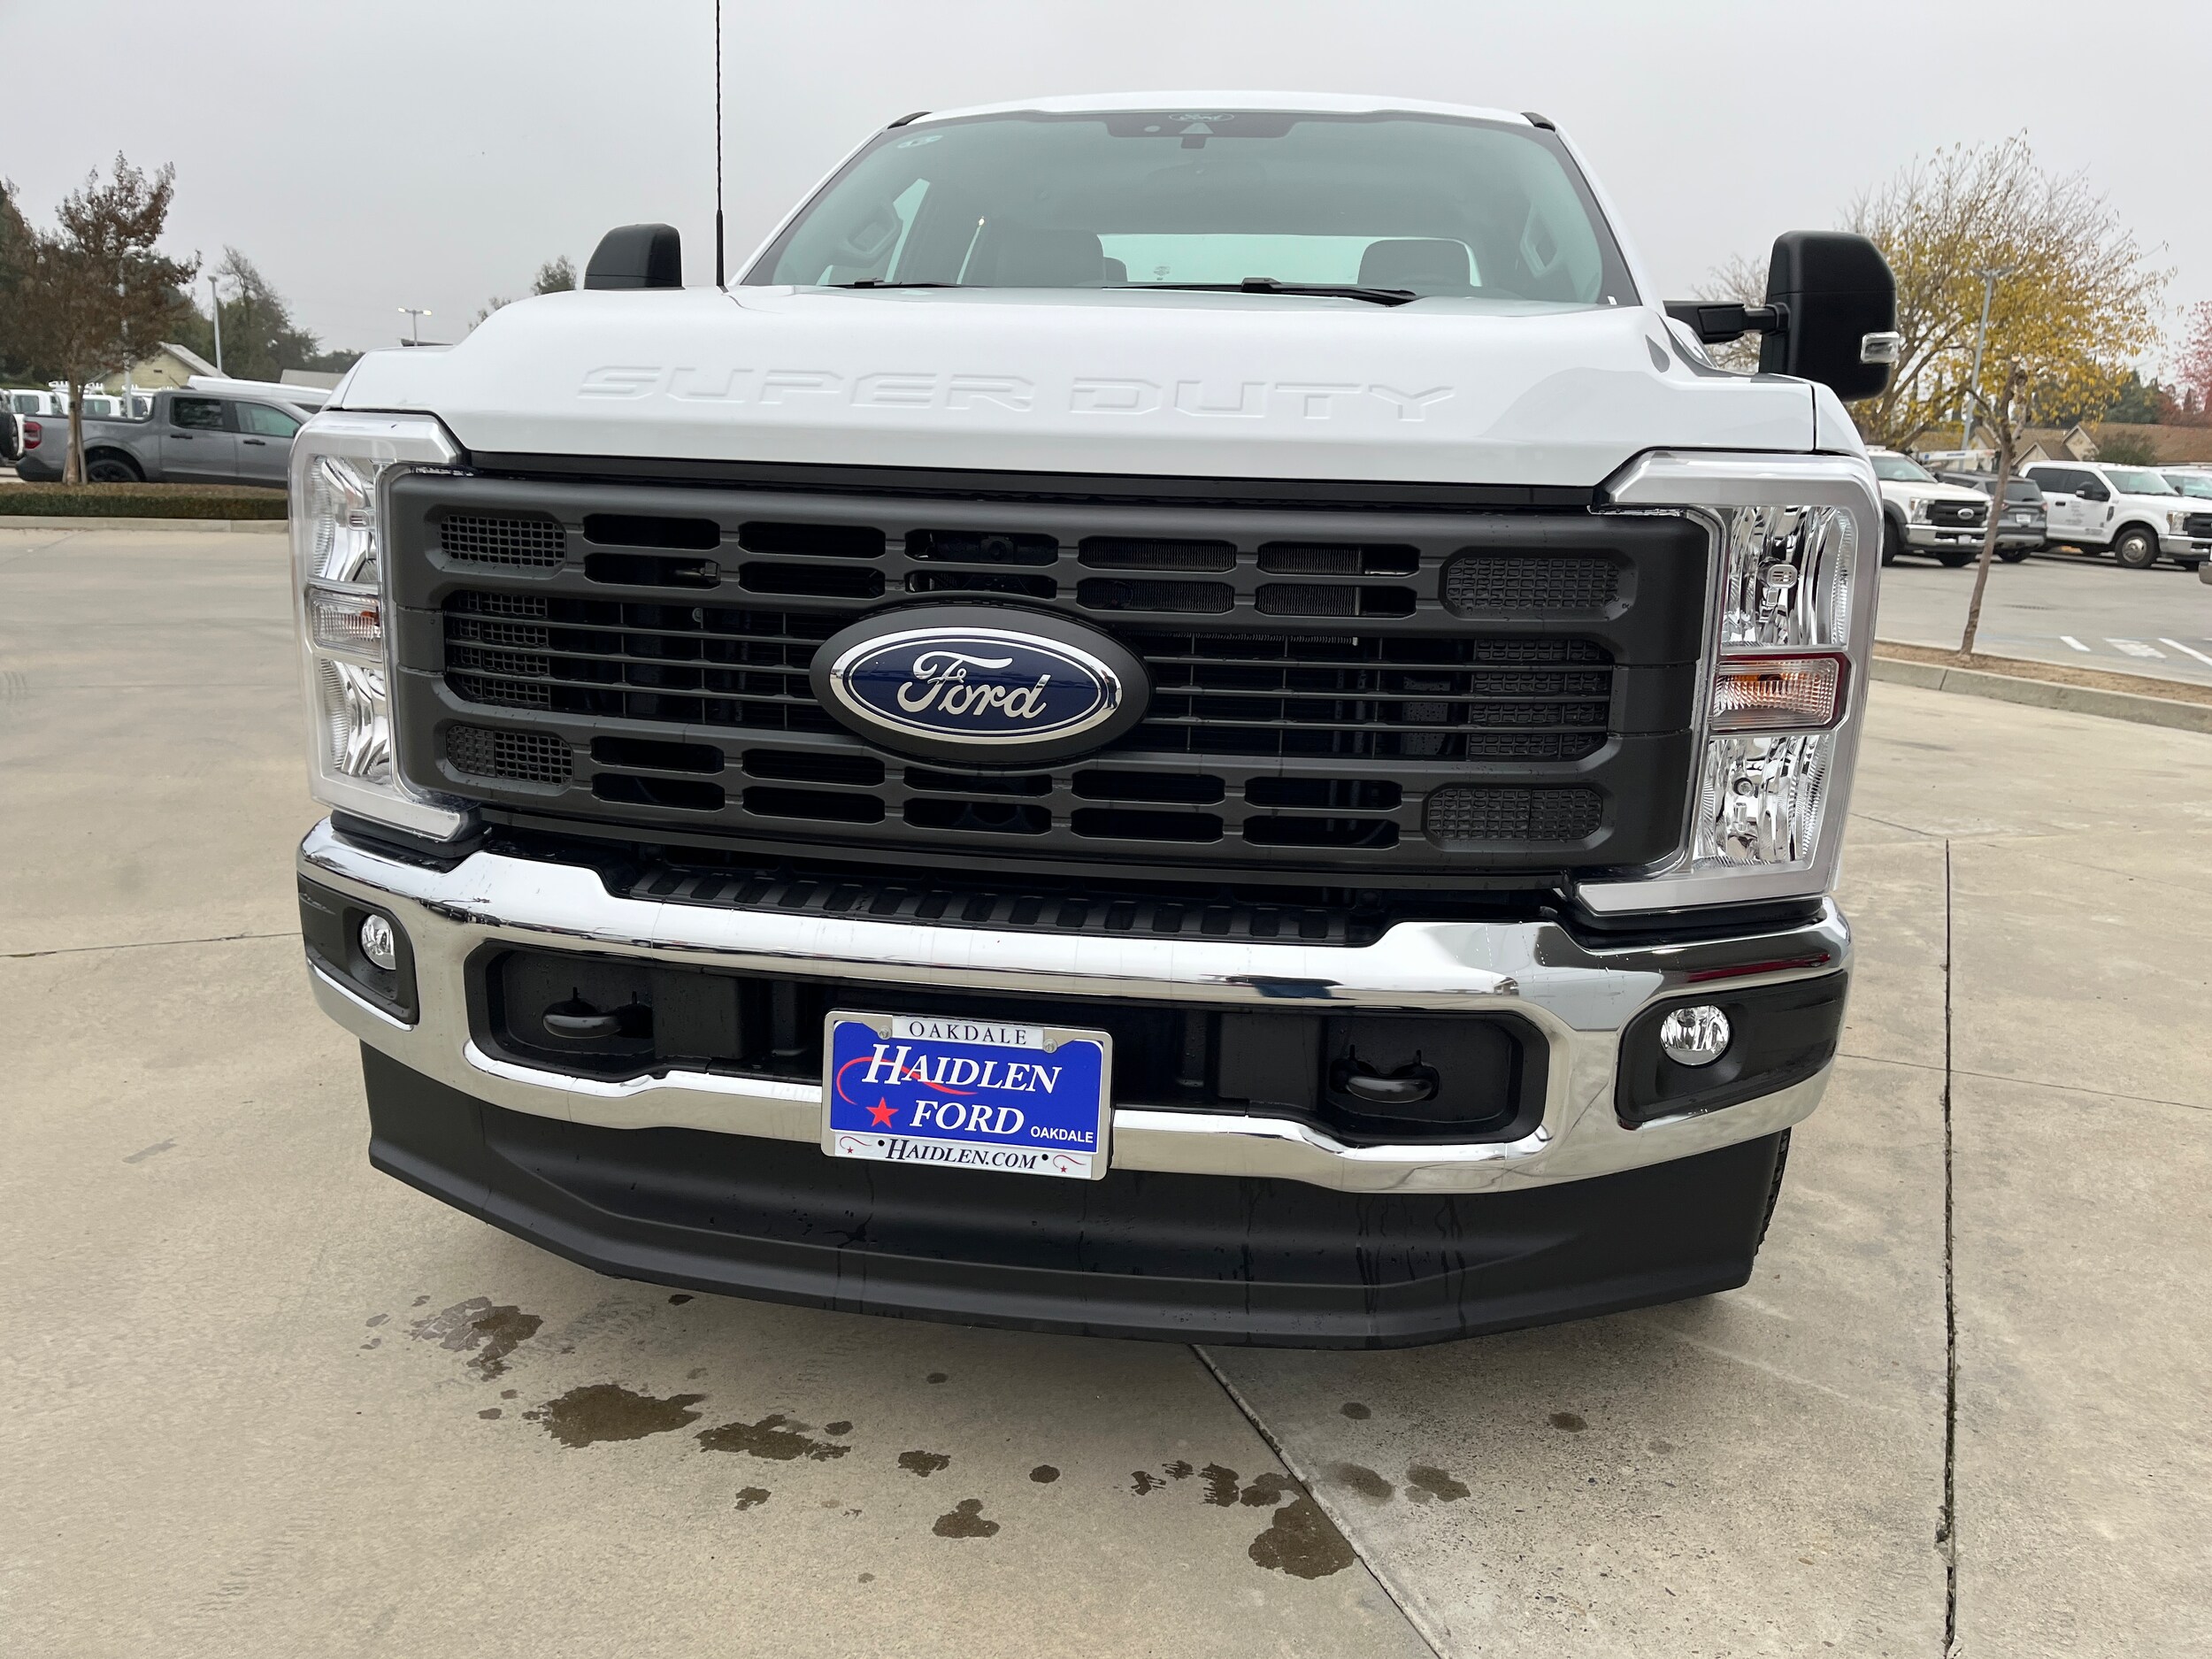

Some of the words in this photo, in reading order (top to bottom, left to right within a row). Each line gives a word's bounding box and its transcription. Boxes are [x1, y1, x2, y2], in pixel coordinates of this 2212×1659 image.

[577, 365, 1036, 412] SUPER
[1069, 376, 1458, 422] DUTY
[896, 650, 1052, 718] Ford
[909, 1020, 1027, 1045] OAKDALE
[862, 1043, 1063, 1094] HAIDLEN
[910, 1099, 1025, 1135] FORD
[1030, 1125, 1094, 1144] OAKDALE
